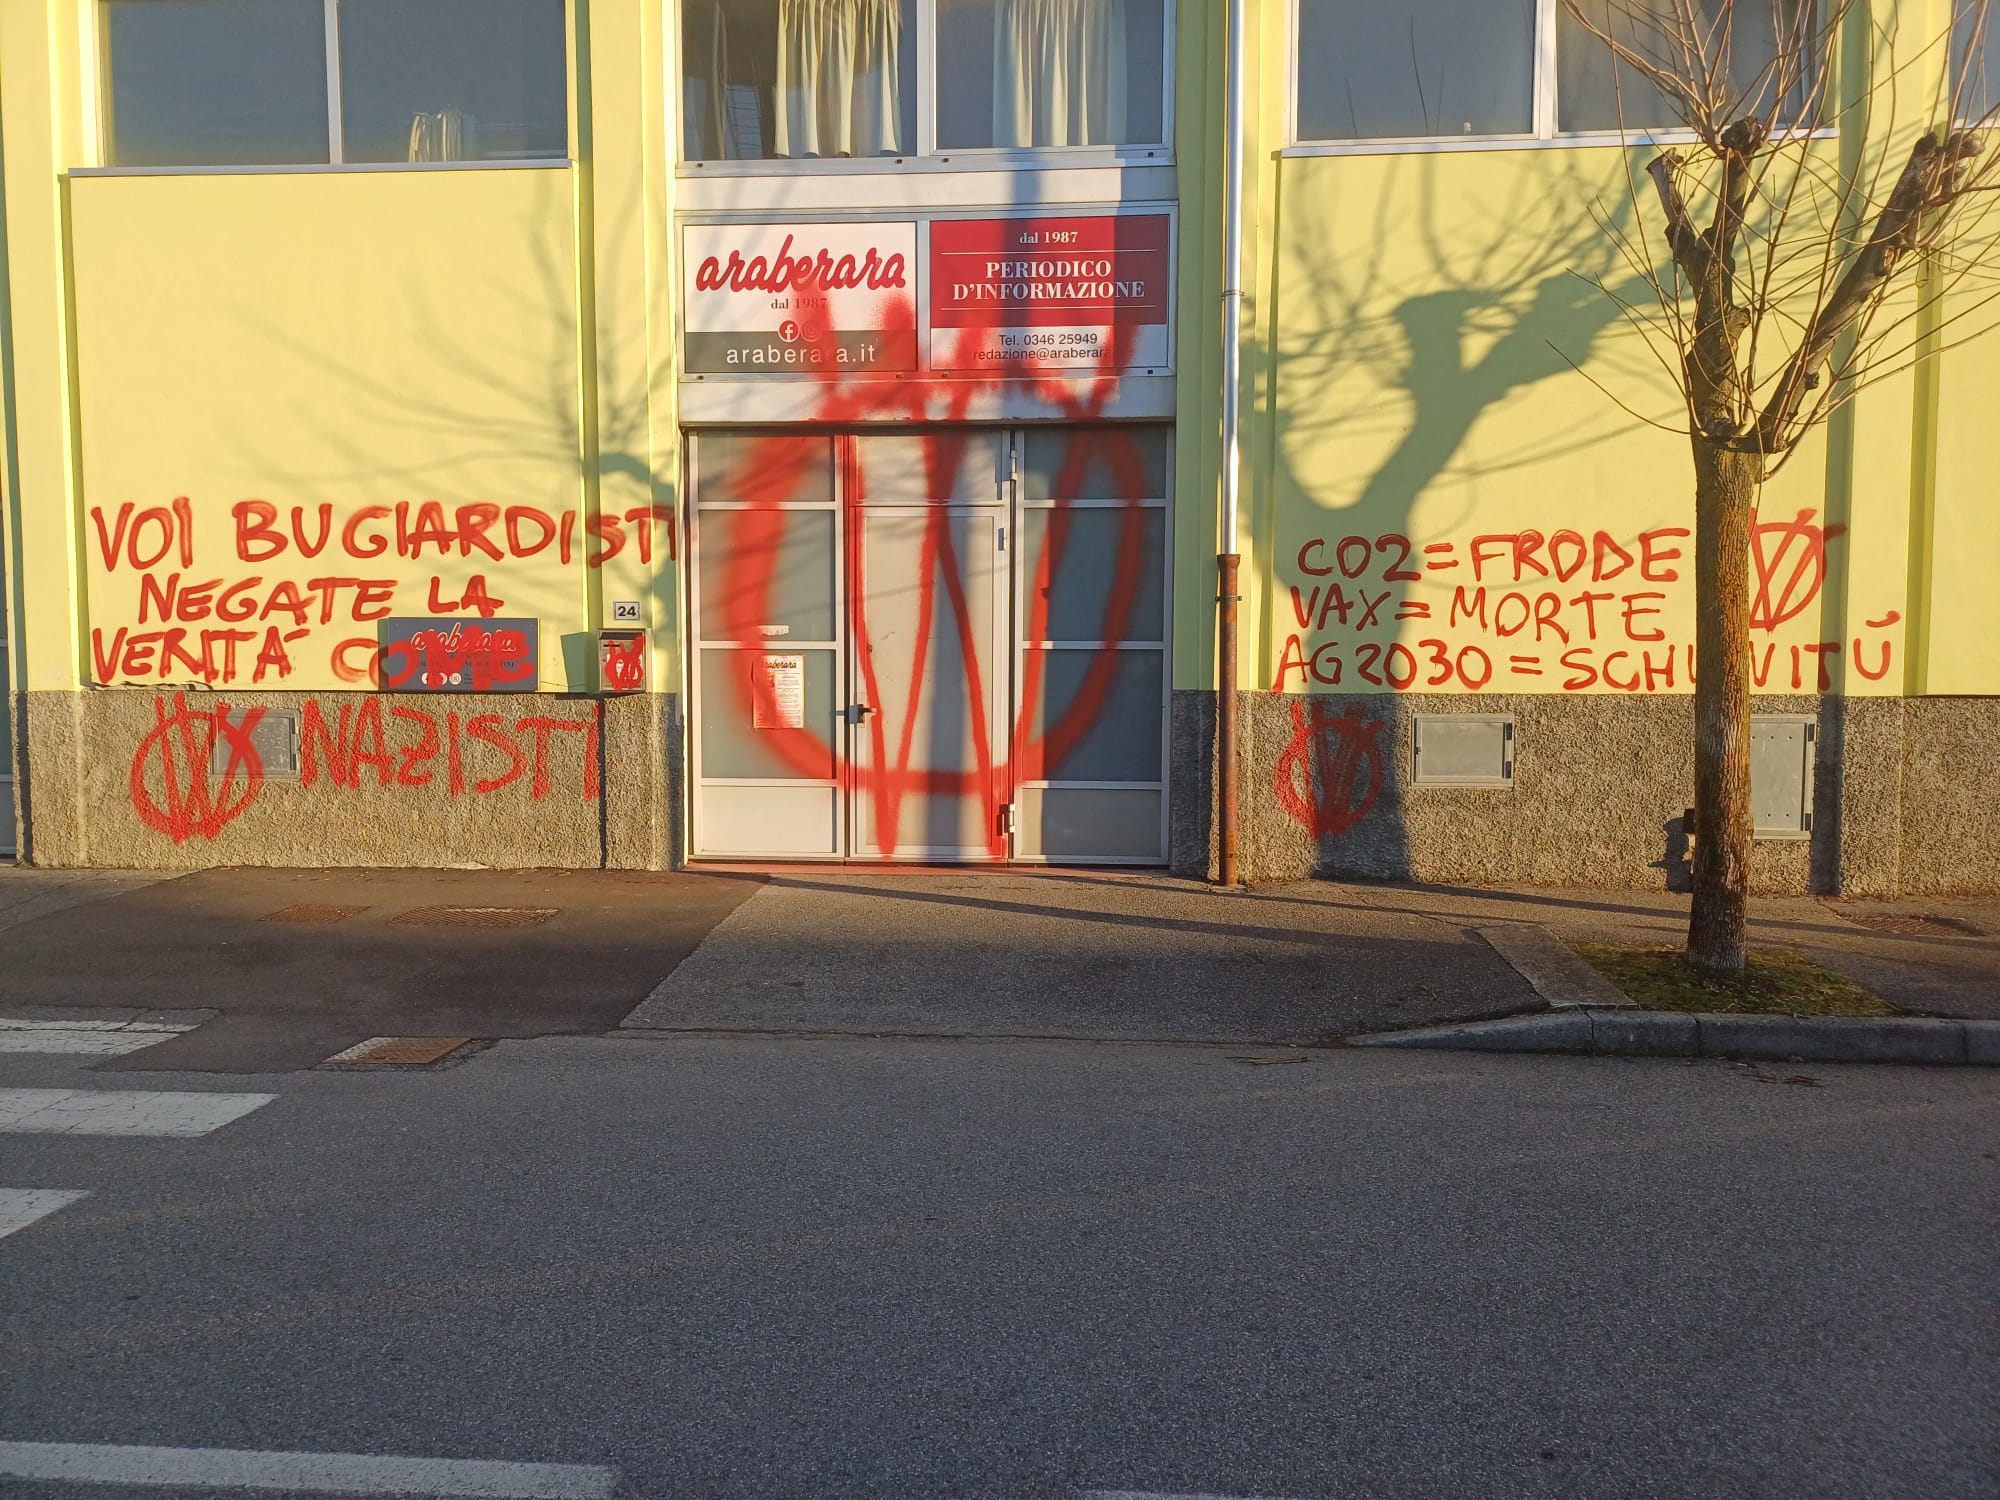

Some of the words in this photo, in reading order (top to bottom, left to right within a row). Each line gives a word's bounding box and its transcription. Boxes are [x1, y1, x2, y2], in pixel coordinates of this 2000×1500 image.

[695, 233, 906, 294] araberara
[1019, 232, 1039, 245] dal
[1043, 231, 1079, 244] 1987
[952, 280, 1145, 300] D'INFORMAZIONE
[985, 259, 1112, 279] PERIODICO
[770, 298, 789, 309] dal
[795, 297, 828, 309] 1987
[998, 334, 1019, 346] Tel.
[1023, 333, 1055, 346] 0346
[1058, 332, 1098, 345] 25949
[90, 496, 193, 572] VOI
[232, 499, 677, 570] BUGIARDISTI
[1470, 526, 1691, 584] FRODE
[138, 572, 399, 626] NEGATE
[428, 574, 504, 618] LA
[617, 605, 637, 617] 24
[1449, 584, 1667, 645] MORTE
[331, 625, 536, 691] COME
[301, 694, 606, 801] NAZISTI
